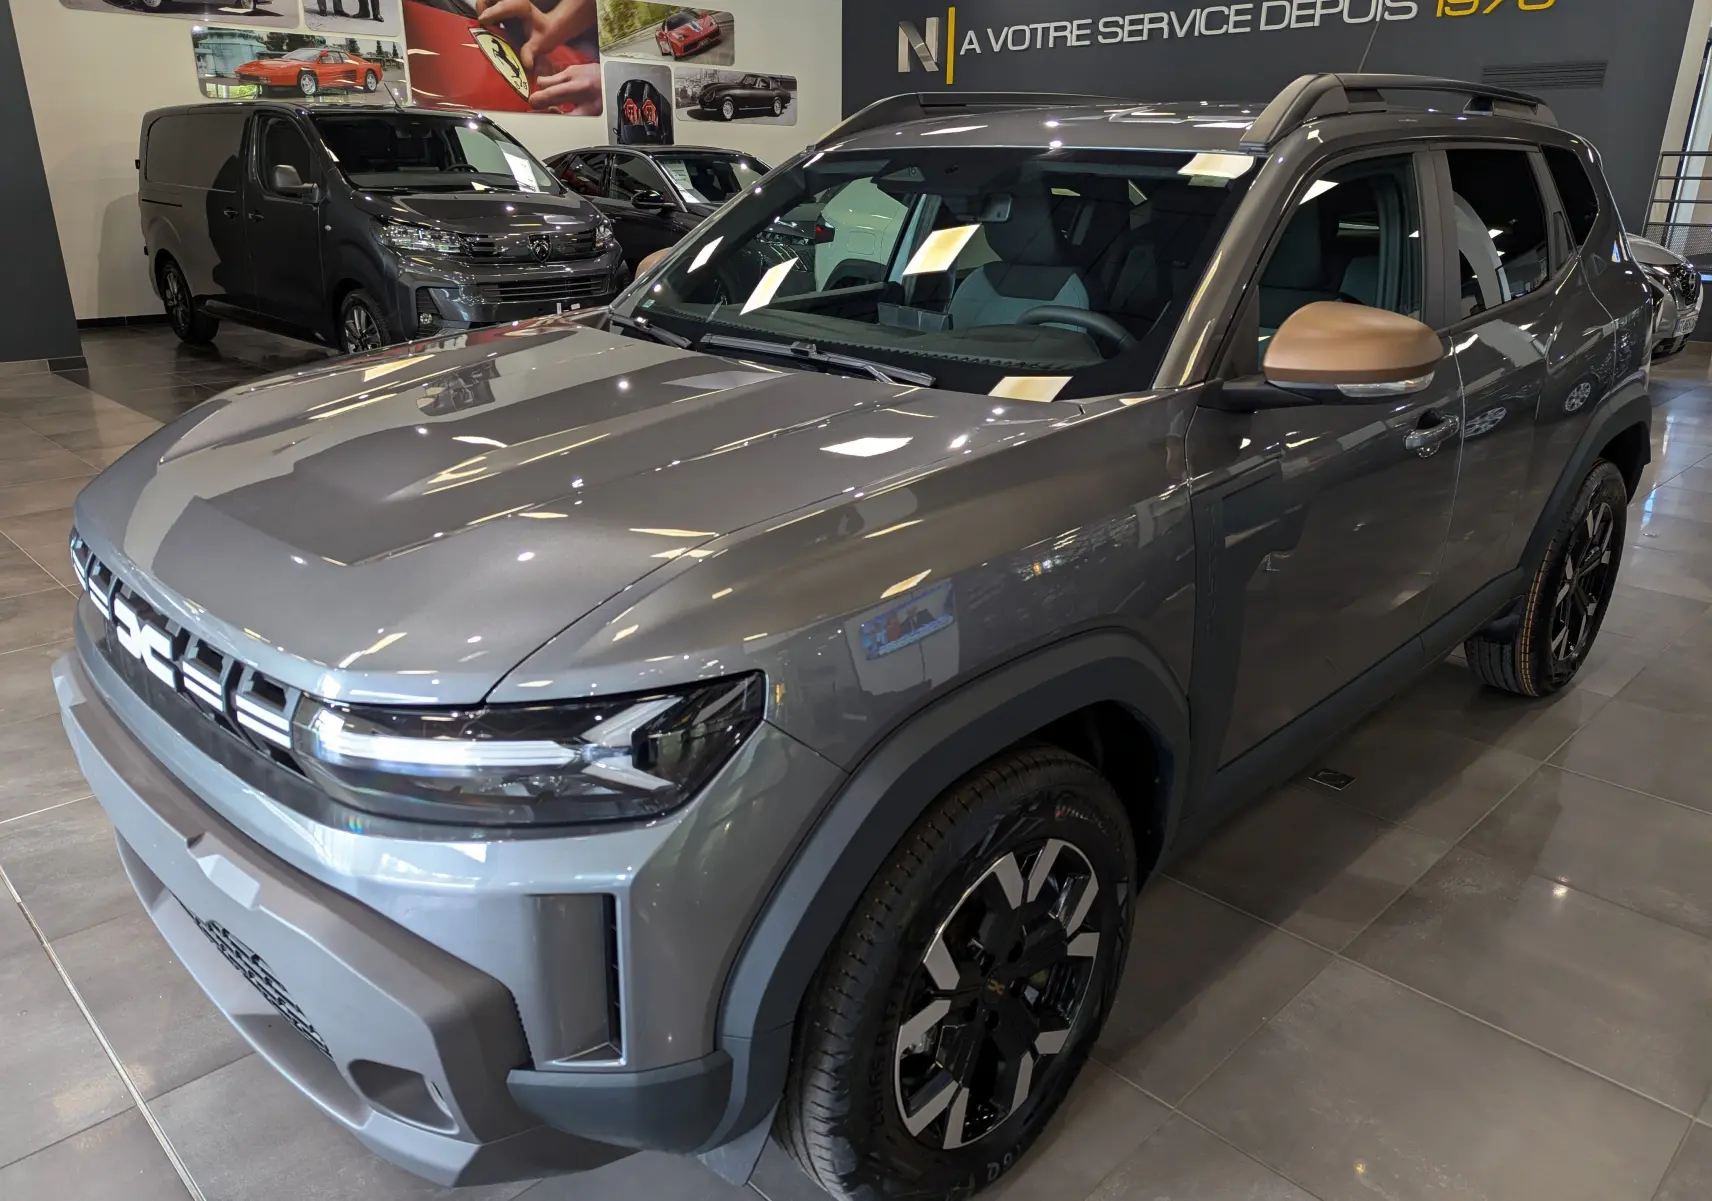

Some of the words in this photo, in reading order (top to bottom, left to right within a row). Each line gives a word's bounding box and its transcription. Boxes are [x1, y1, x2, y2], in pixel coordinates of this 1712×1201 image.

[960, 30, 982, 55] A
[986, 19, 1093, 52] VOTRE
[1097, 3, 1254, 44] SERVICE
[1260, 0, 1418, 31] DEPUIS
